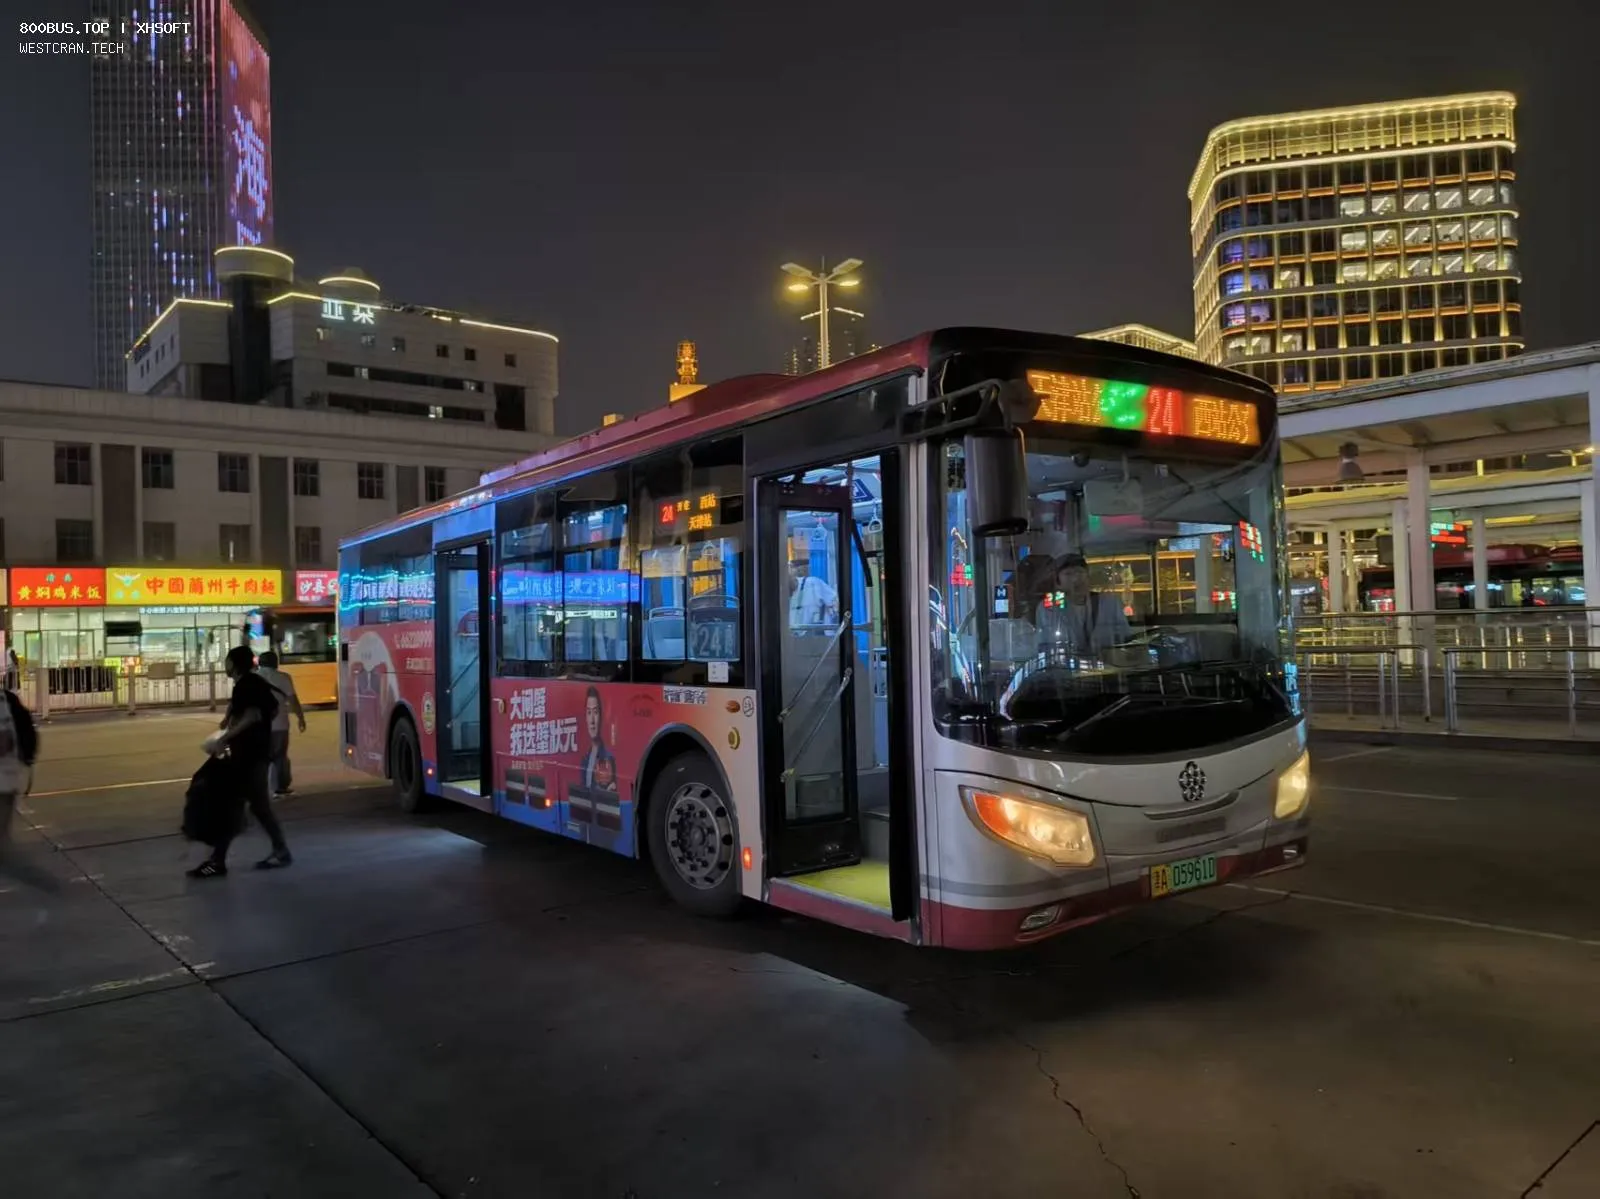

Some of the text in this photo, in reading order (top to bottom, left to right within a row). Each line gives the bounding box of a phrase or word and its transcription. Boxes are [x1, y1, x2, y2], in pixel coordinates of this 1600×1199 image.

[321, 299, 375, 325] 亚朵
[1148, 389, 1174, 436] 24
[662, 505, 674, 523] 24
[17, 585, 102, 601] 黄焖鸡米饭
[510, 687, 546, 721] 大闸蟹
